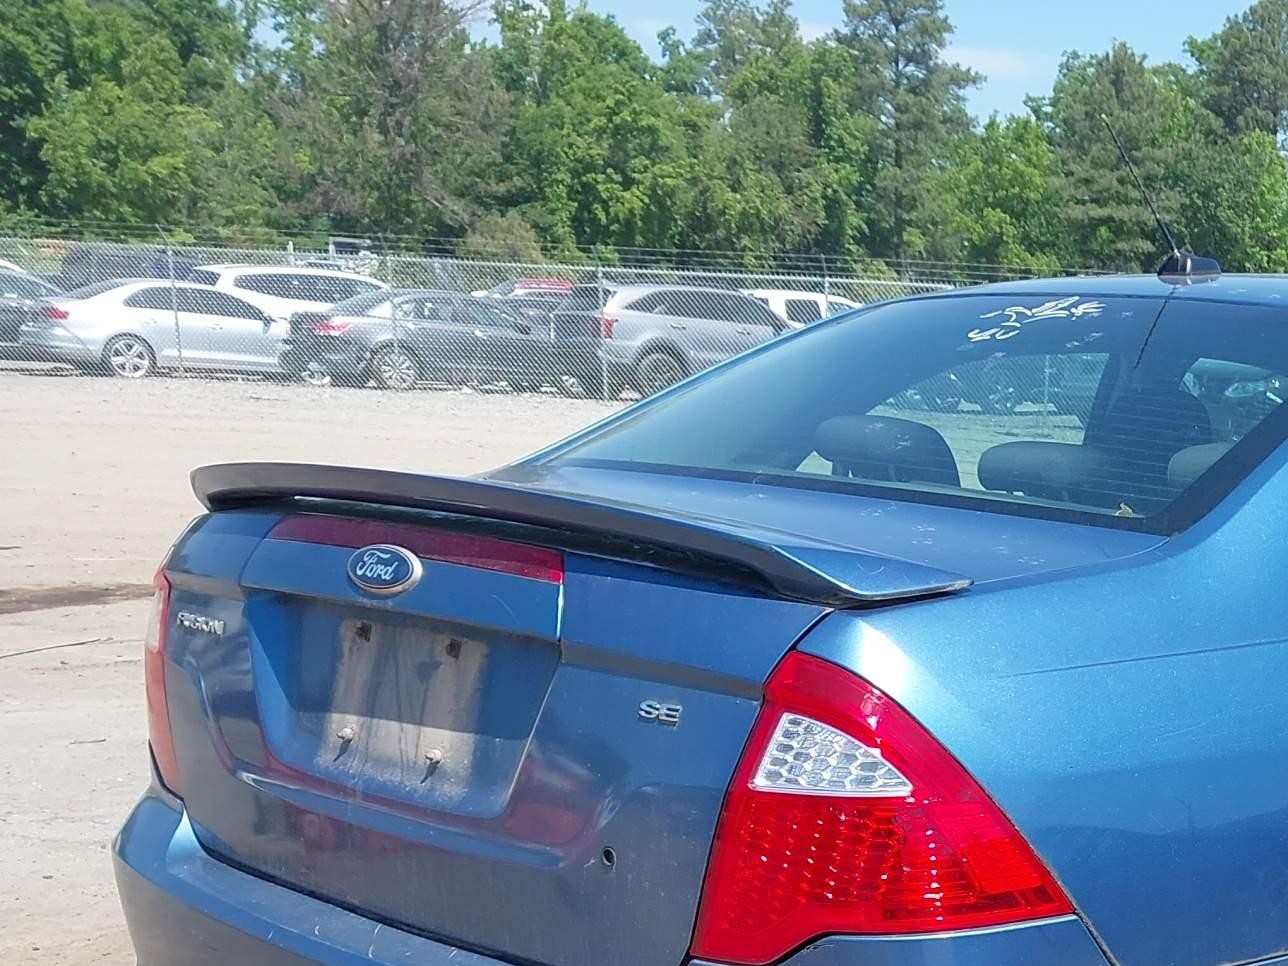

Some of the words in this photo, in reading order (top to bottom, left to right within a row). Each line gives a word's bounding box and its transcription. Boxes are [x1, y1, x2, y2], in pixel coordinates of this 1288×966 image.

[356, 549, 399, 580] Ford
[177, 611, 225, 635] FUSION
[638, 700, 683, 726] SE
